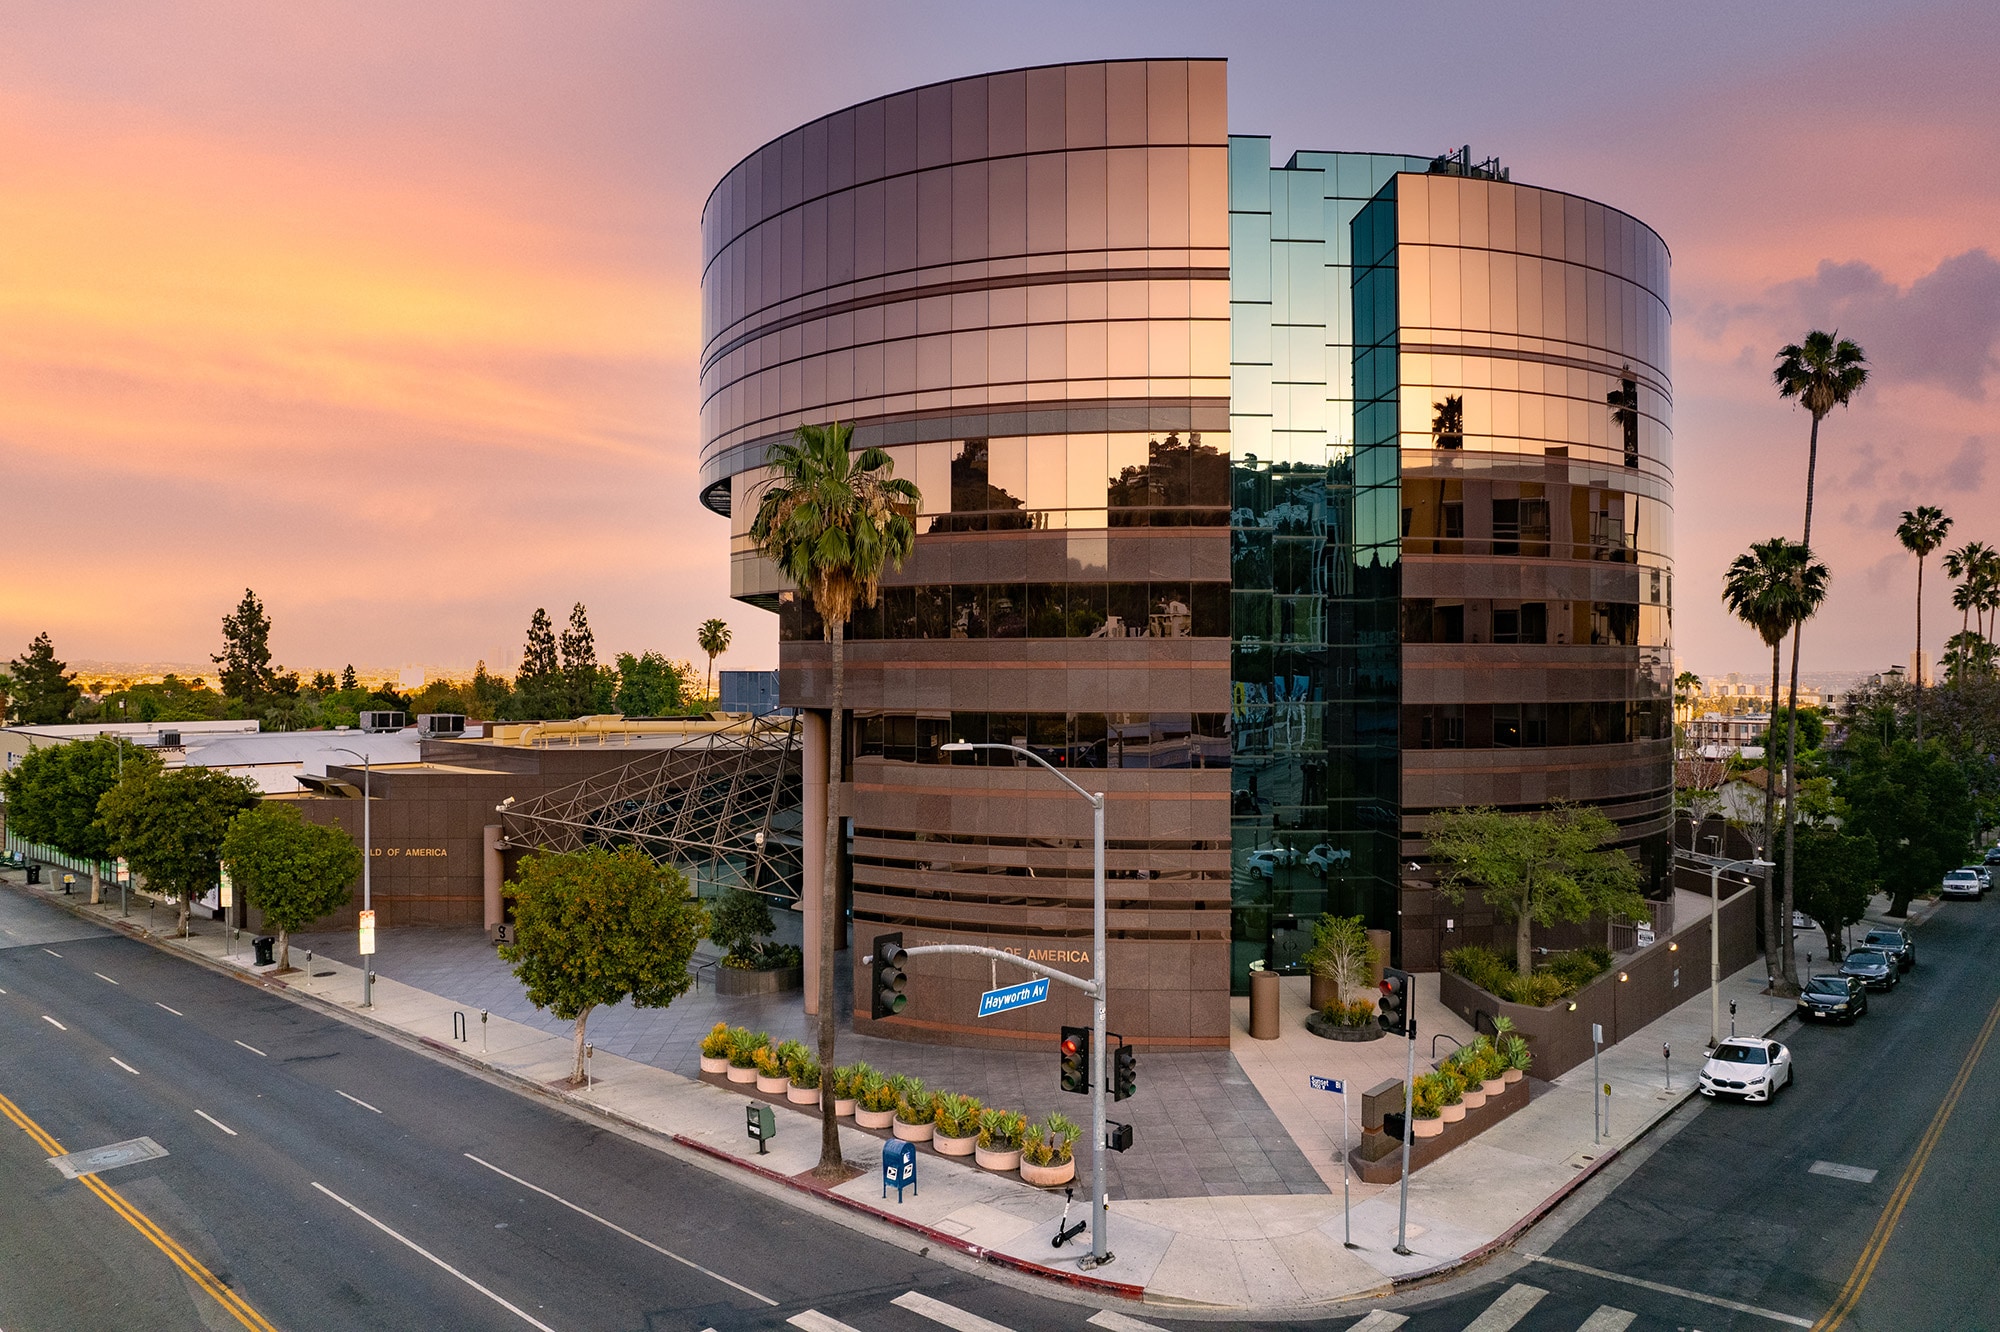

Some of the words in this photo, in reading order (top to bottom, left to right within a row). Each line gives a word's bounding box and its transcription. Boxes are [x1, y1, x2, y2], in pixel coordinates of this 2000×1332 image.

[387, 848, 401, 857] OF
[405, 848, 448, 857] AMERICA
[1027, 949, 1090, 963] AMERICA
[985, 988, 1030, 1010] Hayworth
[1032, 985, 1045, 999] Av
